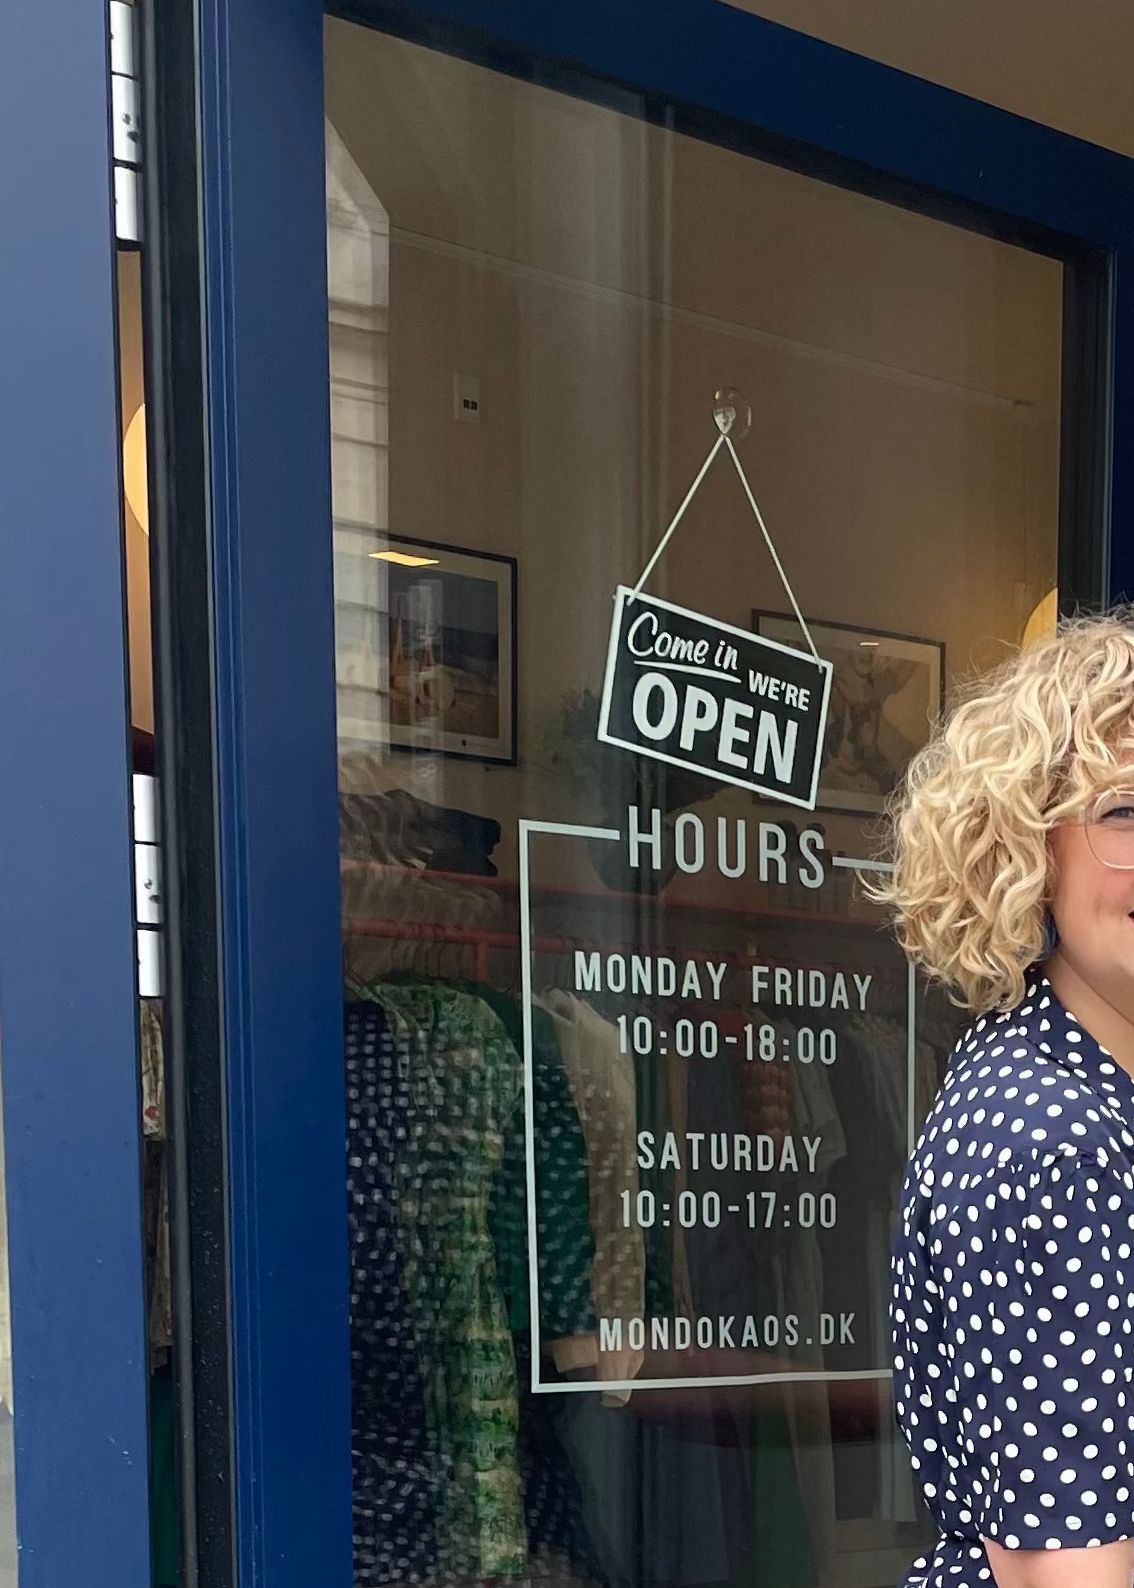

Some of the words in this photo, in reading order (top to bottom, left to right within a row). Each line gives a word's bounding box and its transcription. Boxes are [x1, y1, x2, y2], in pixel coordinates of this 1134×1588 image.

[626, 611, 710, 664] Come
[714, 639, 738, 670] in
[748, 669, 810, 712] WE'RE
[632, 672, 799, 784] OPEN
[628, 805, 825, 889] HOURS
[574, 950, 727, 1000] MONDAY
[752, 965, 873, 1011] FRIDAY
[616, 1014, 837, 1065] 10:00-18:00
[636, 1130, 822, 1173] SATURDAY
[620, 1189, 836, 1228] 10:00-17:00
[599, 1312, 856, 1352] MONDOKAOS.DK
